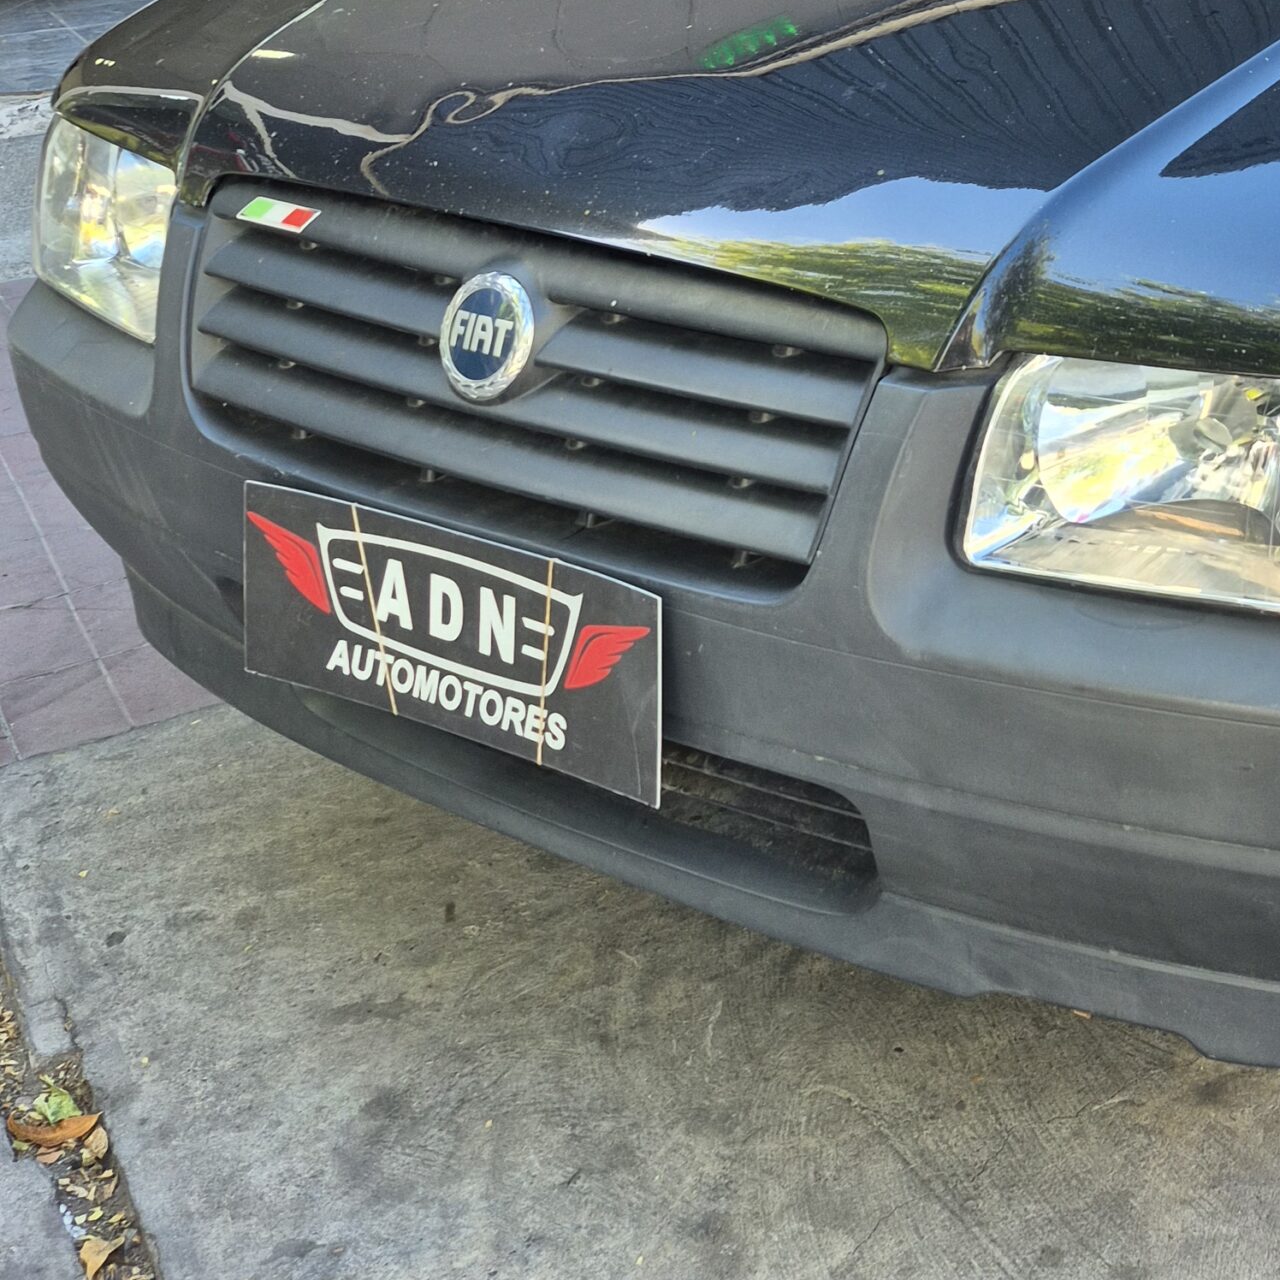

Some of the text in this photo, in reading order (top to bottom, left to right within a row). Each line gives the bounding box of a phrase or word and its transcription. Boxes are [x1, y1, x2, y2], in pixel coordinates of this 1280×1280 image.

[450, 309, 514, 358] FIAT
[375, 558, 516, 664] ADN
[326, 638, 567, 751] AUTOMOTORES
